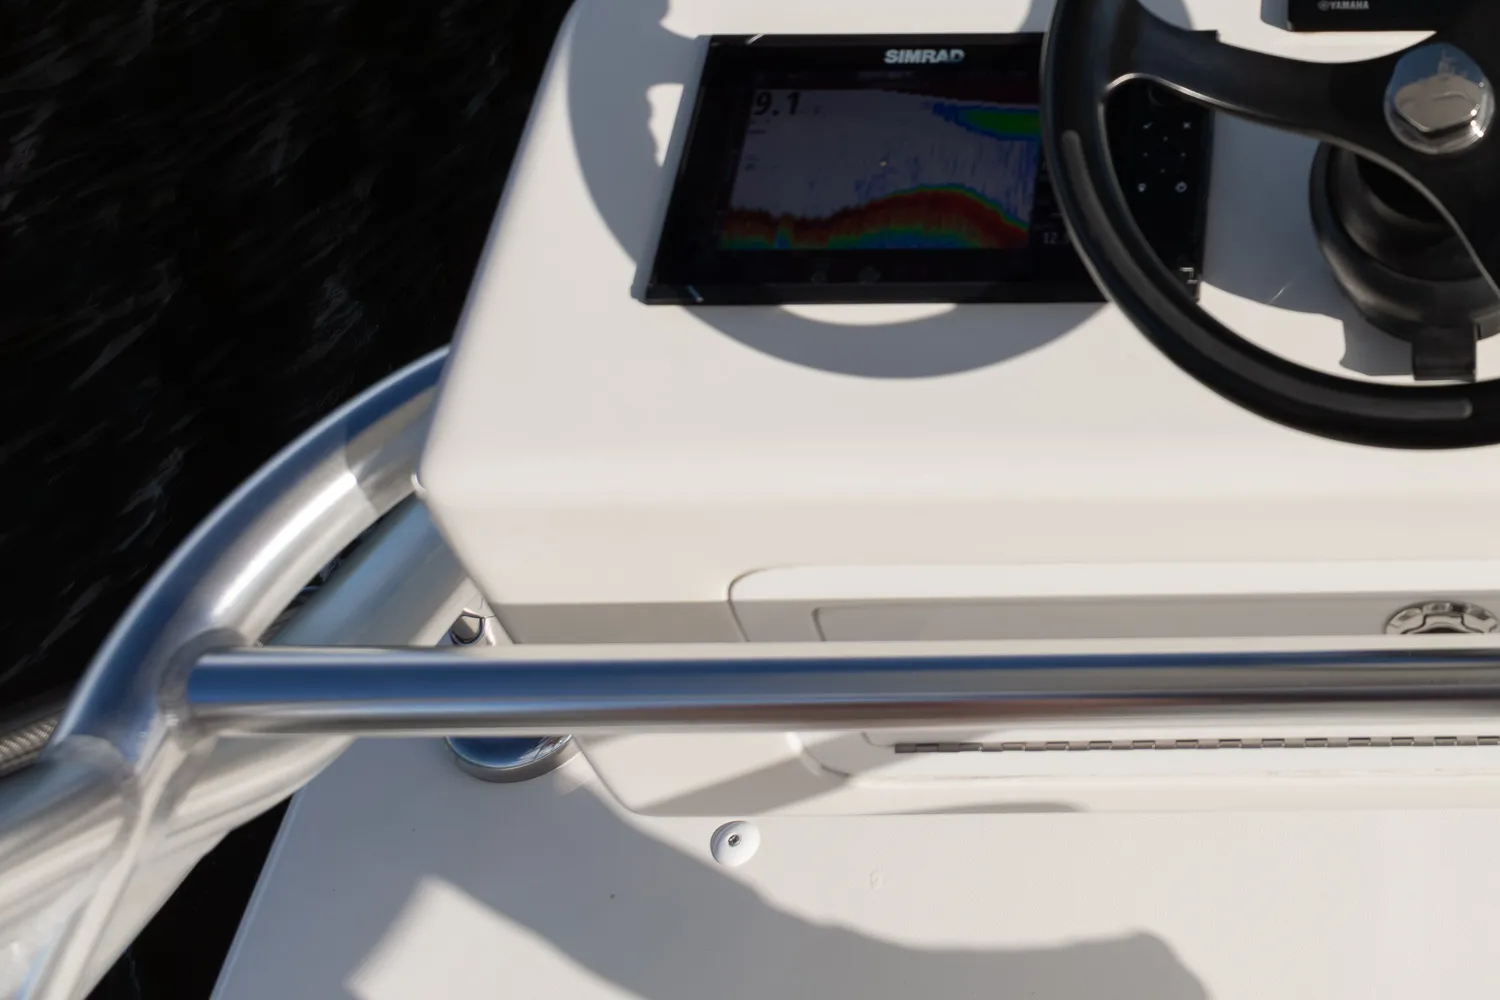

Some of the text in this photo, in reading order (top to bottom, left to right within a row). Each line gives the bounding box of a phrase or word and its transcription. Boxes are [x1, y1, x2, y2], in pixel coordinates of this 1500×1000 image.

[1330, 0, 1369, 9] YAMAHA
[884, 49, 965, 64] SIMRAD
[752, 91, 800, 115] 9.1
